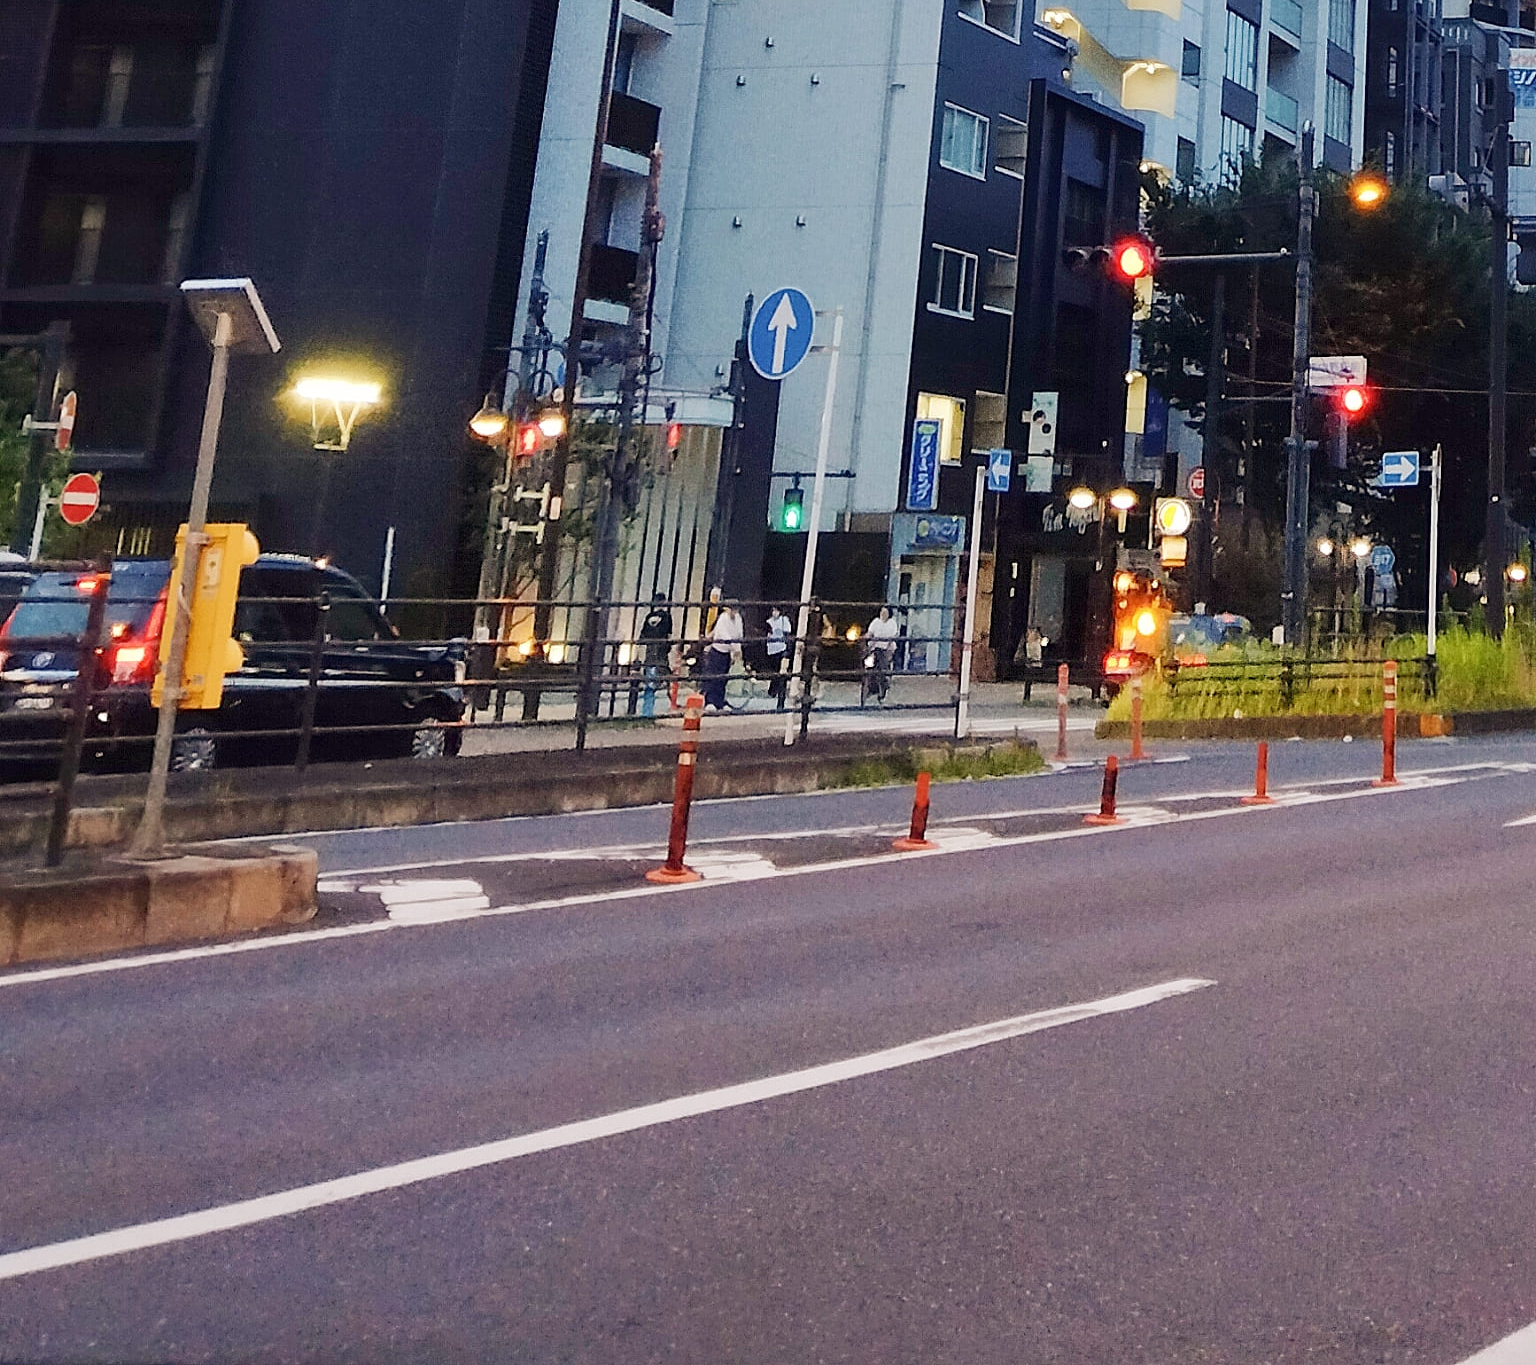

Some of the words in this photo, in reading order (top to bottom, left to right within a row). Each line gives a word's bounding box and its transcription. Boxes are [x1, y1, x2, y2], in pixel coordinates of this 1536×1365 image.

[917, 435, 931, 501] クリーニング
